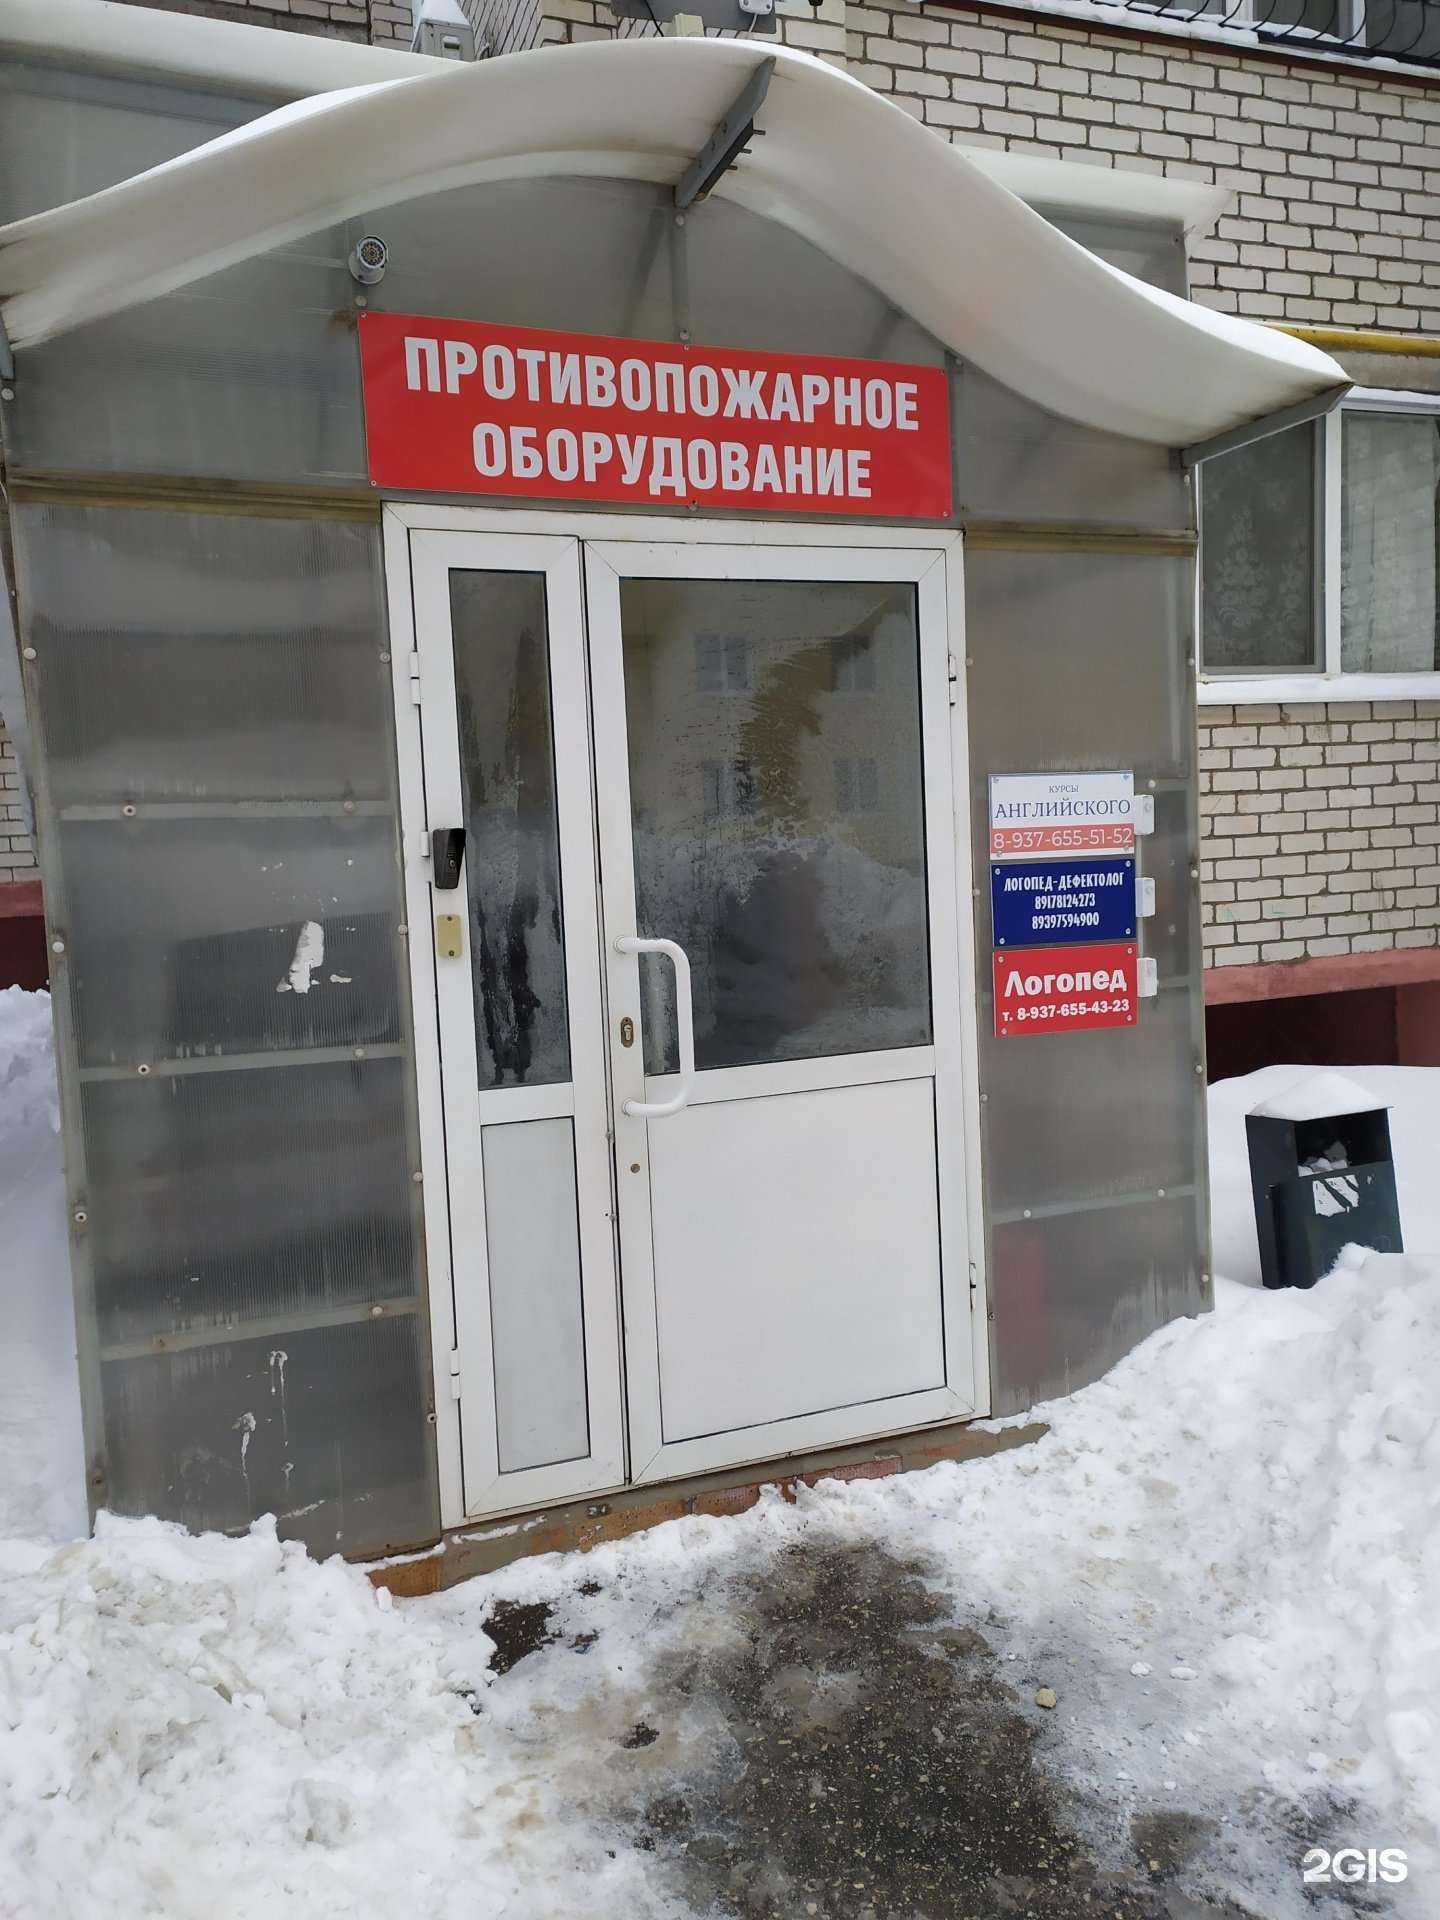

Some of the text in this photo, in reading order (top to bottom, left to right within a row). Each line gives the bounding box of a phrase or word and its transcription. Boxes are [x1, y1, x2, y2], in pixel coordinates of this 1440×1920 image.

[404, 336, 919, 432] ПРОТИВОПОЖАРНОЕ
[472, 423, 873, 499] ОБОРУДОВАНИЕ
[1048, 784, 1079, 794] КУРСЫ
[995, 797, 1131, 819] АНГЛИЙСКОГО
[993, 828, 1132, 849] 8-937-655-51-52
[1004, 872, 1125, 892] ЛОГОПЕД-ДЕФЕКТОЛОГ
[1035, 893, 1096, 909] 89178124273
[1032, 912, 1100, 929] 89397594900
[1004, 969, 1127, 998] Логопед
[1002, 999, 1130, 1022] т. 8-937-655-43-23
